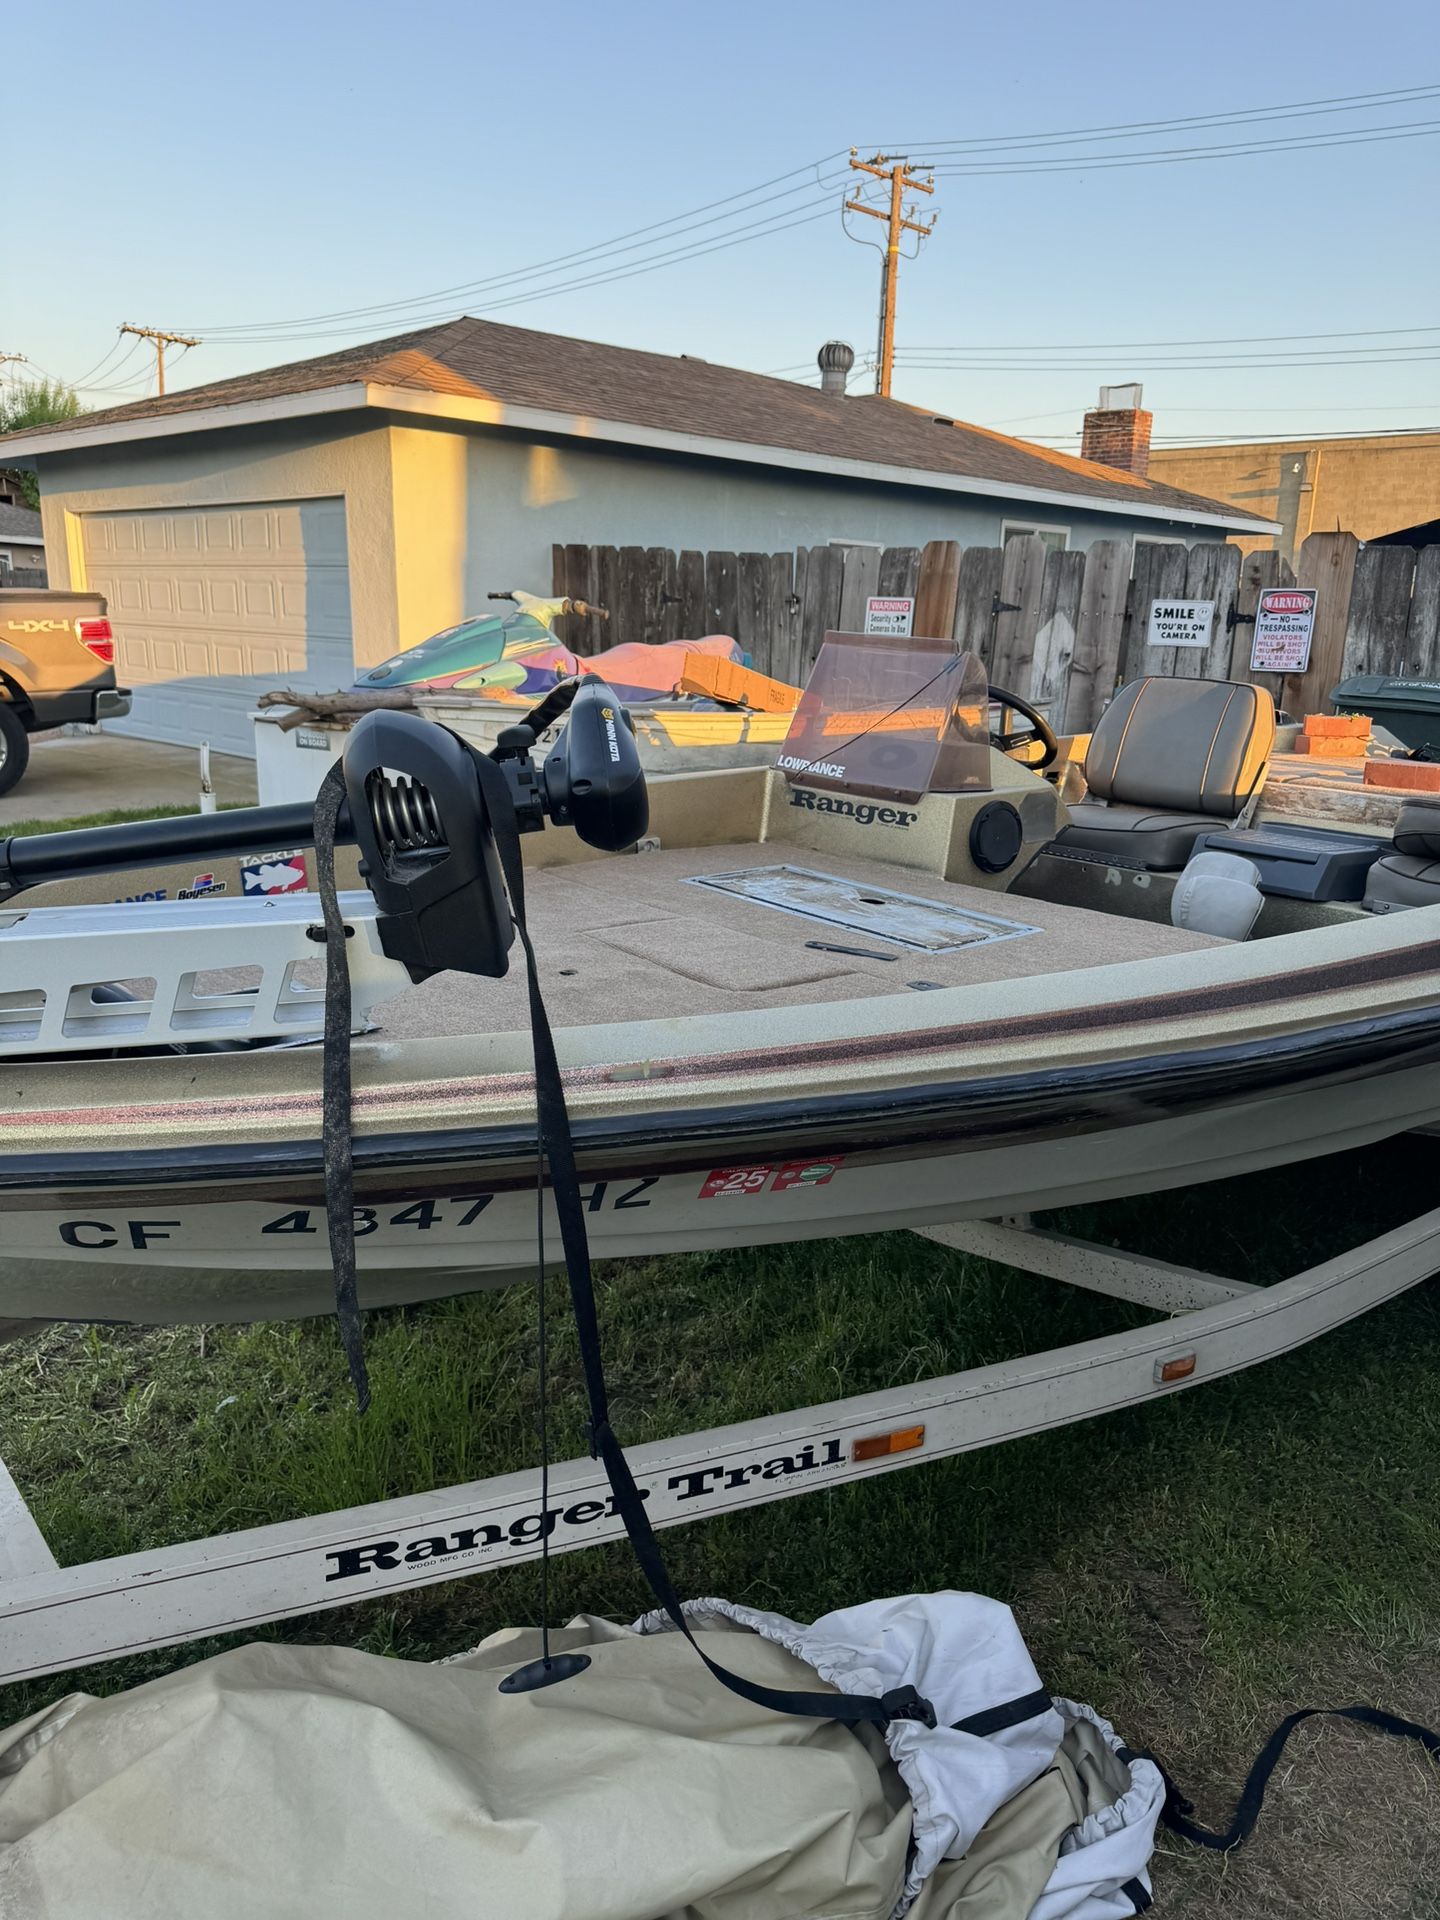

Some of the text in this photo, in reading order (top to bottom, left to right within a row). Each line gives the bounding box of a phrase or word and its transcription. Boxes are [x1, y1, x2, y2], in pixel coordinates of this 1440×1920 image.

[871, 601, 909, 611] WARNING
[1265, 597, 1311, 610] WARNING
[871, 613, 891, 624] Security
[1154, 607, 1196, 620] SMILE
[1280, 615, 1291, 624] NO
[870, 623, 890, 632] Cameras
[897, 625, 906, 634] Use
[1156, 622, 1206, 632] YOU'RE ON
[1259, 624, 1309, 633] TRESPASSING
[1161, 631, 1197, 640] CAMERA
[1263, 633, 1304, 641] VIOLATORS
[300, 737, 328, 747] ON BOARD
[604, 719, 620, 762] MINN KOTA
[777, 755, 846, 778] LOWRANCE
[789, 788, 918, 828] Ranger
[240, 849, 304, 868] TACKLE
[178, 882, 226, 900] Boyesen
[722, 1169, 769, 1190] 25
[59, 1220, 182, 1250] CF
[667, 1438, 846, 1501] Trail
[407, 1545, 493, 1571] WOOD MFG CO INC
